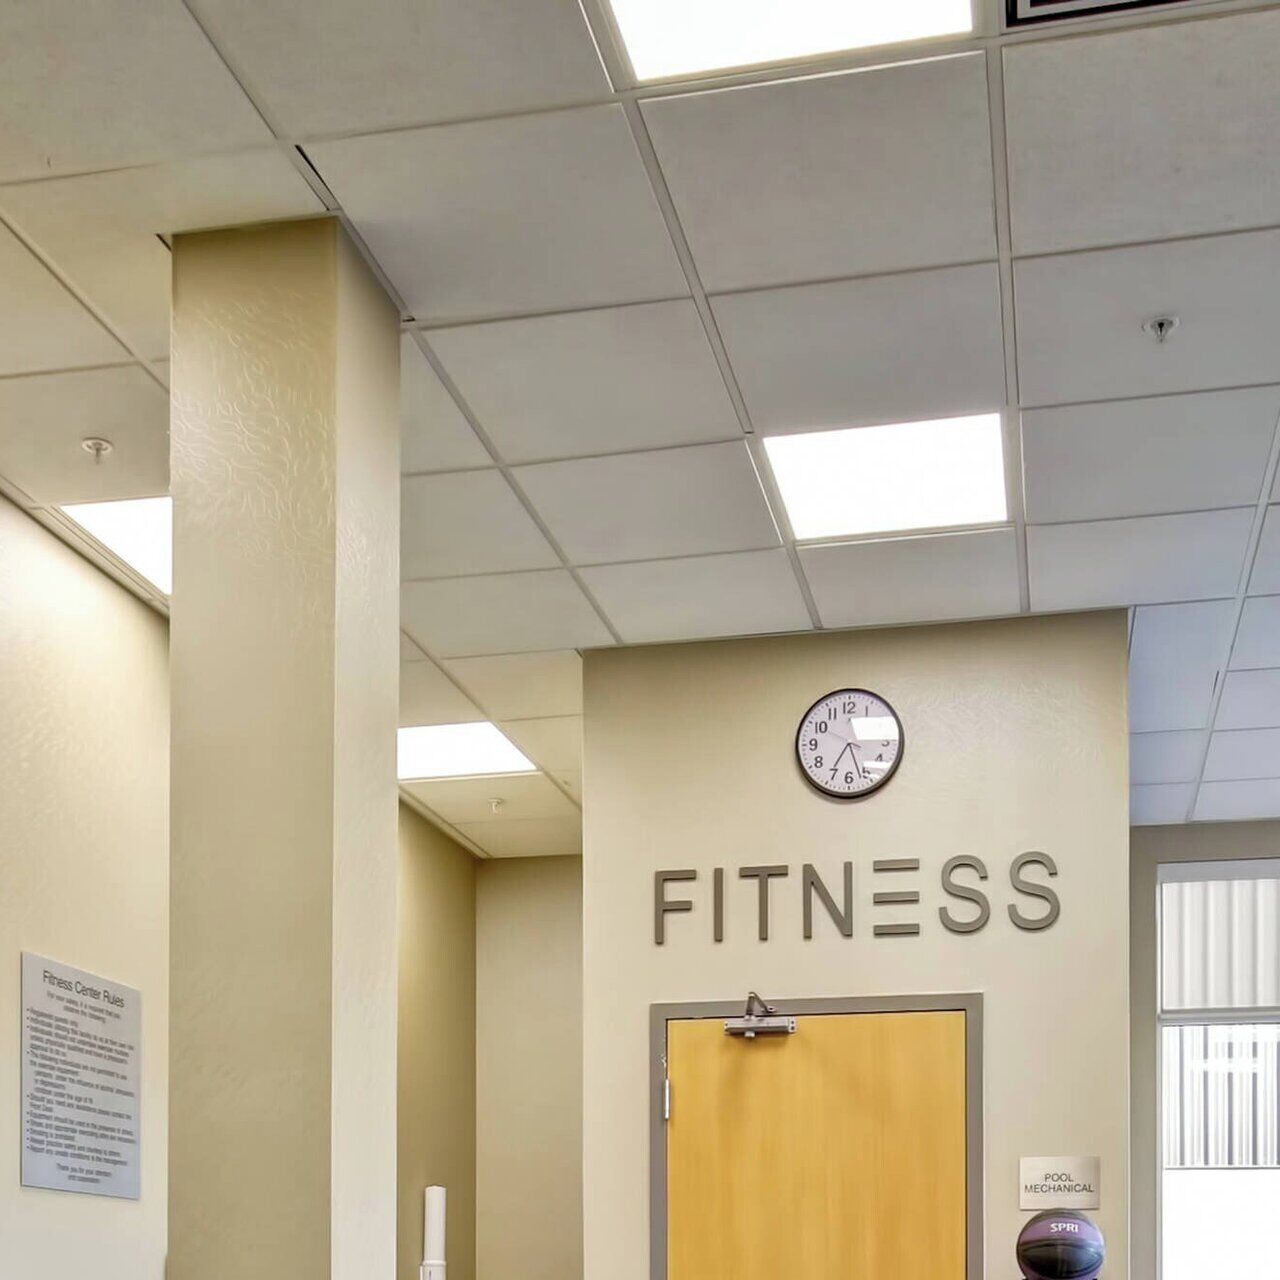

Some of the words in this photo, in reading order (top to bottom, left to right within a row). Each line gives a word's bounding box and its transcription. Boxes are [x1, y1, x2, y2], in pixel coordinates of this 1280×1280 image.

[828, 707, 837, 720] 11
[842, 701, 856, 714] 12
[865, 705, 869, 717] 1
[815, 721, 828, 733] 10
[809, 738, 818, 751] 9
[814, 756, 823, 769] 8
[829, 768, 838, 780] 7
[844, 771, 854, 784] 6
[654, 851, 1061, 945] FITNESS
[42, 969, 73, 992] Fitness
[75, 980, 101, 1000] Center
[103, 989, 125, 1008] Rules
[1044, 1173, 1074, 1183] POOL
[1024, 1184, 1094, 1193] MECHANICAL
[1050, 1222, 1079, 1232] SPRI
